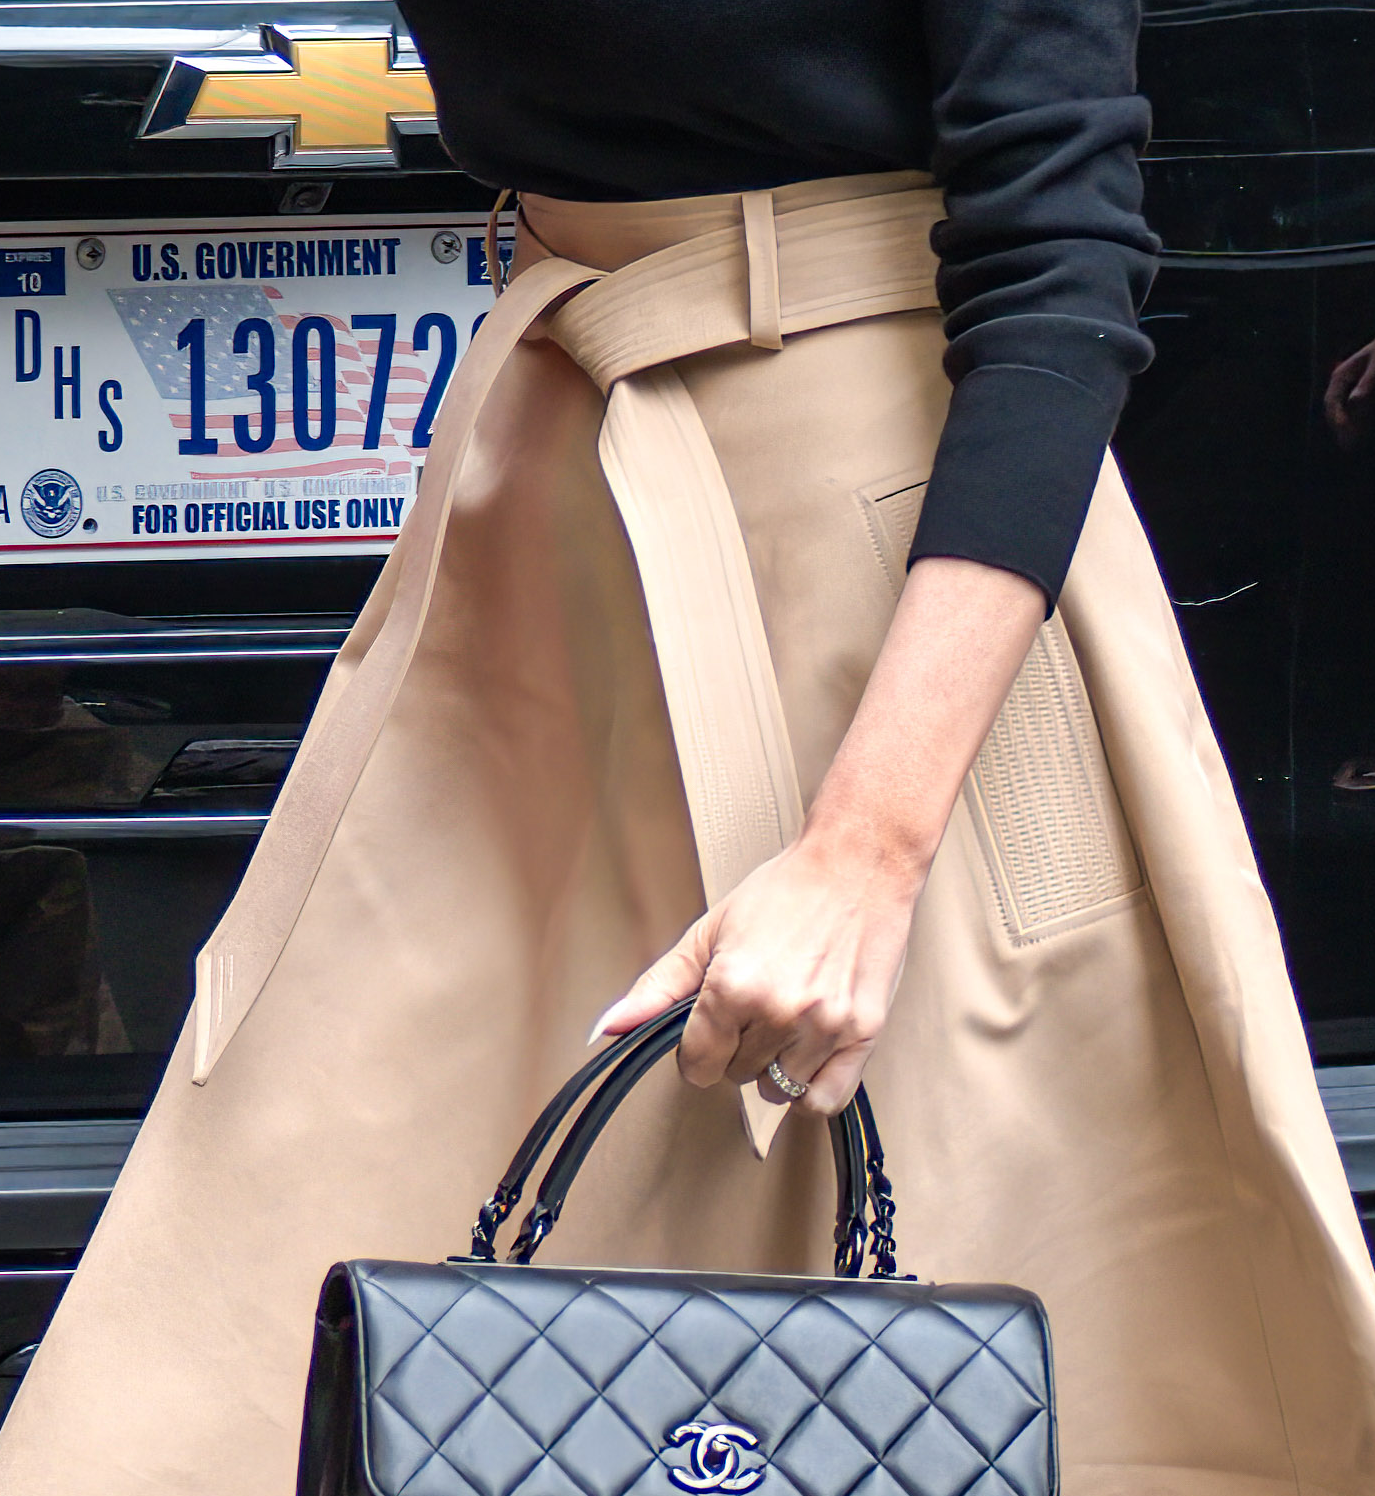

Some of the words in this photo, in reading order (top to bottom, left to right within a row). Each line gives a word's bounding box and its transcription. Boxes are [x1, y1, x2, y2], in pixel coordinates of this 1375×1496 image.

[132, 243, 187, 281] U.S.
[195, 238, 401, 280] GOVERNMENT
[17, 272, 42, 293] 10
[177, 312, 491, 455] 13072
[132, 504, 177, 534] FOR
[185, 501, 289, 533] OFFICIAL
[295, 499, 340, 530] USE
[346, 497, 404, 528] ONLY
